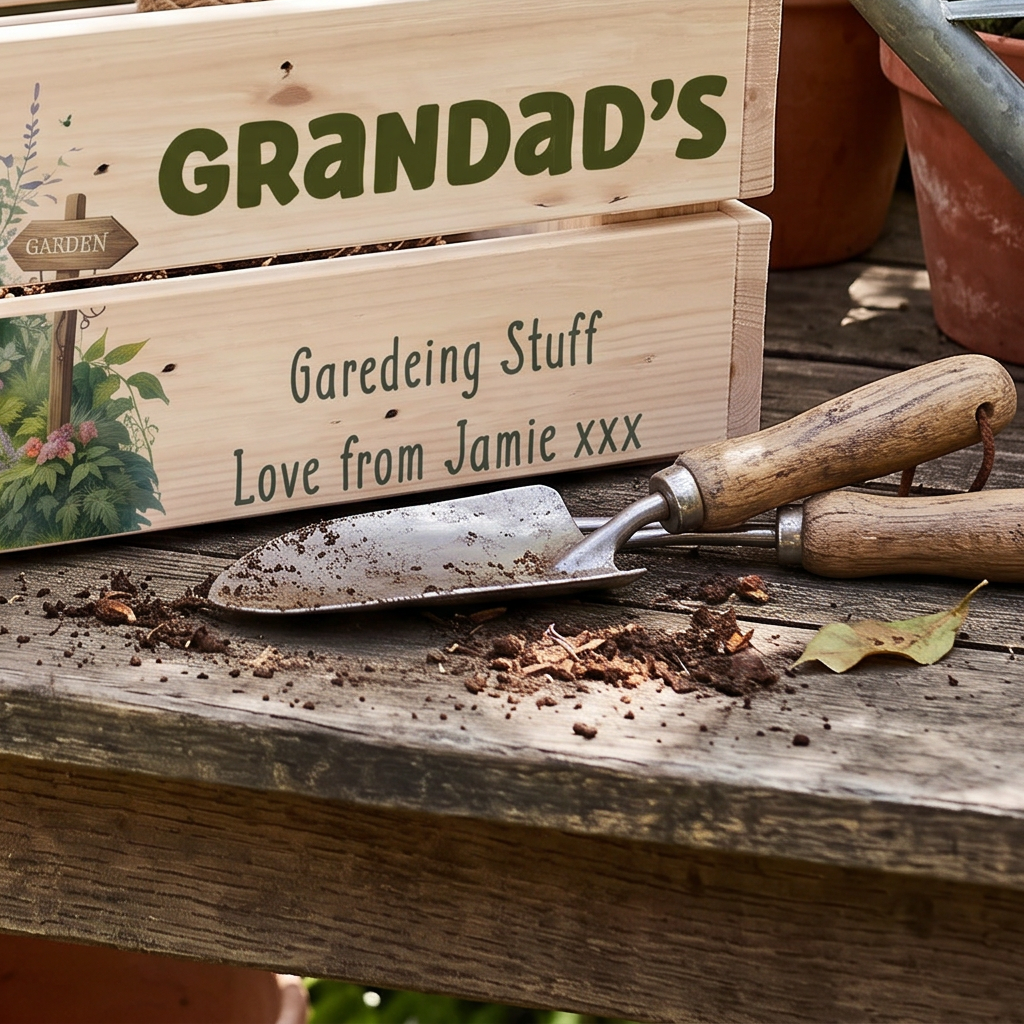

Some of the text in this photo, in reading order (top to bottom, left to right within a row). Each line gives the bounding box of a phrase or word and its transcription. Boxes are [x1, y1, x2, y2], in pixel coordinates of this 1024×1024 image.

[26, 232, 109, 255] GARDEN
[290, 309, 603, 404] Garedeing Stuff
[233, 448, 320, 507] Love
[339, 434, 424, 492] from
[443, 418, 556, 476] Jamie
